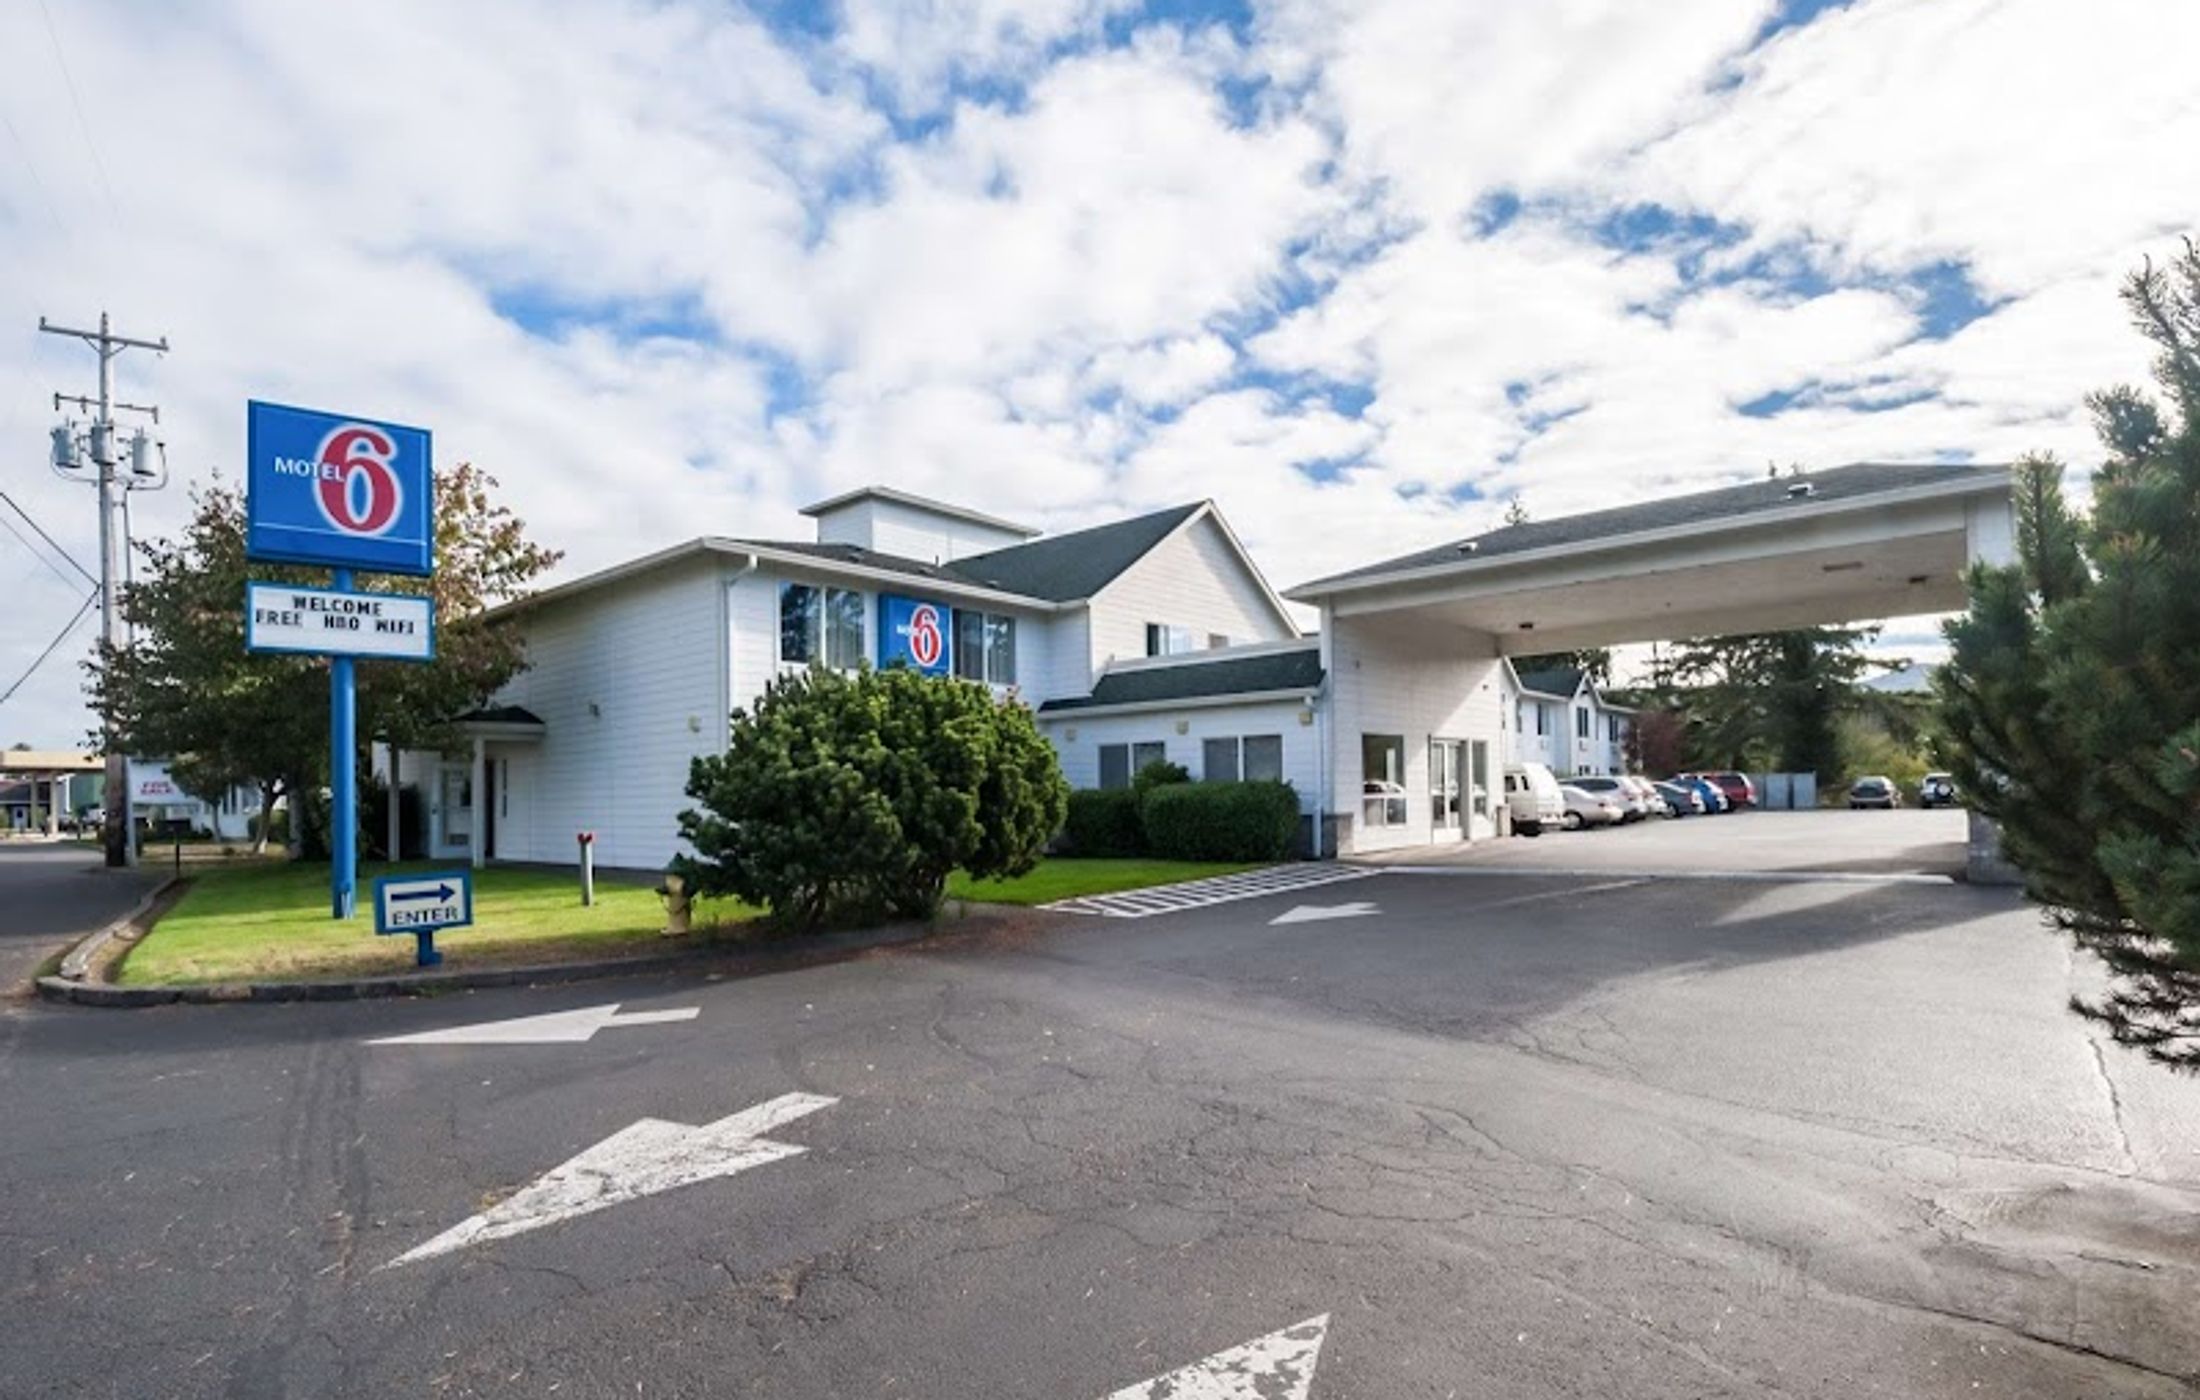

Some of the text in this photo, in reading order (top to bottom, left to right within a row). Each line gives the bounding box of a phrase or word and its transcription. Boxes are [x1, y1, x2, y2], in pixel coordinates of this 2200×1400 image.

[274, 422, 403, 538] MOTEL 6
[292, 595, 383, 617] WELCOME
[255, 608, 415, 635] FREE HBO WIFI
[911, 603, 942, 668] 6
[392, 905, 458, 926] ENTER
